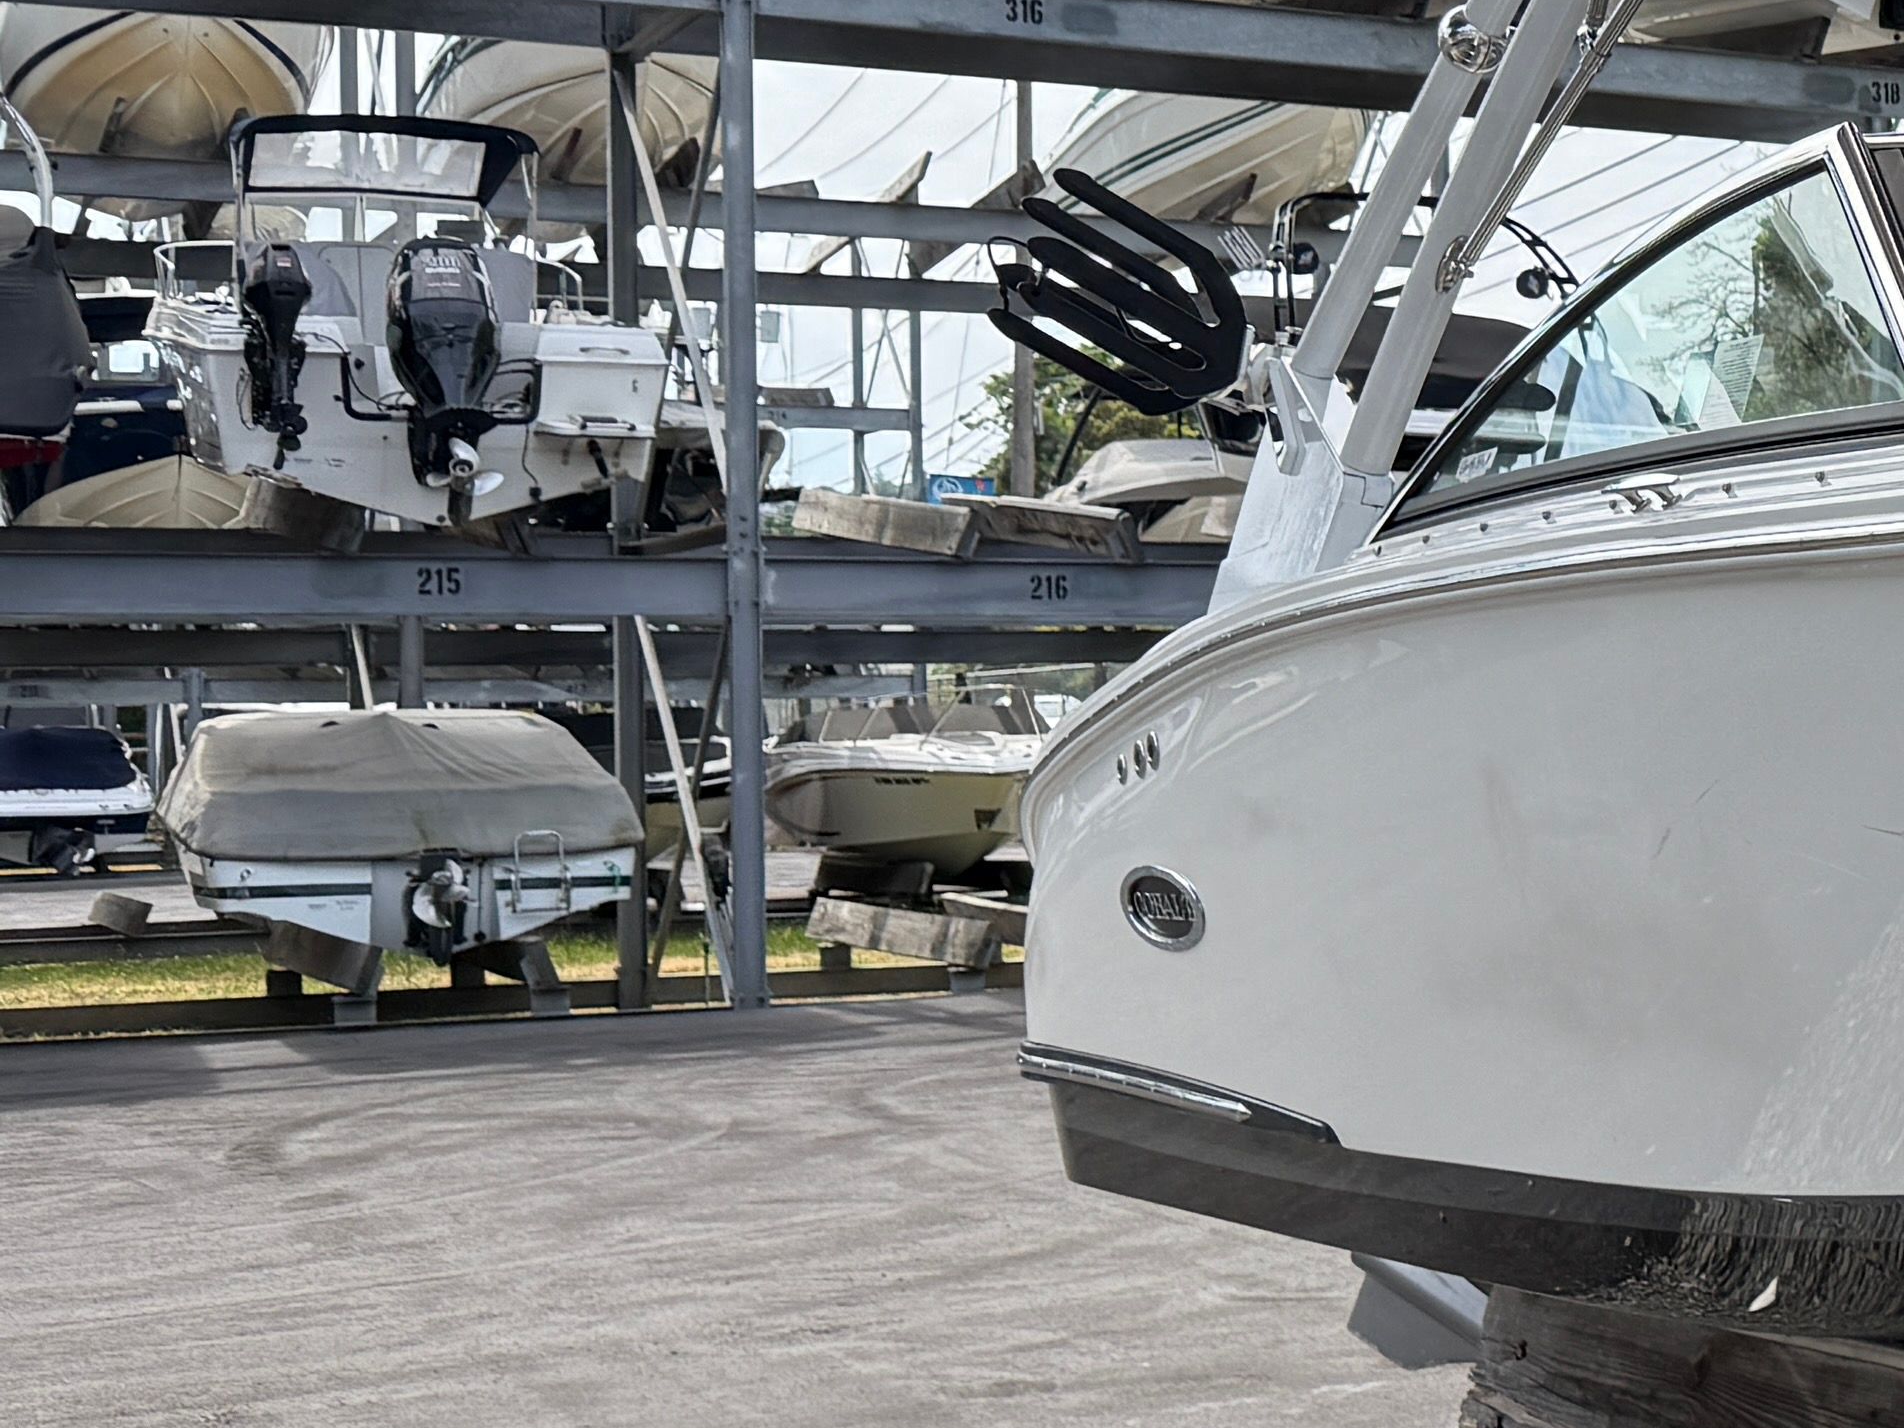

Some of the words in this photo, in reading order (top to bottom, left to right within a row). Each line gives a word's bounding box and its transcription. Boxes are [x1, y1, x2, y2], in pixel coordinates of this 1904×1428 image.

[1872, 82, 1900, 104] 318
[417, 566, 462, 595] 215
[1030, 575, 1068, 600] 216
[1134, 891, 1198, 922] COBALT
